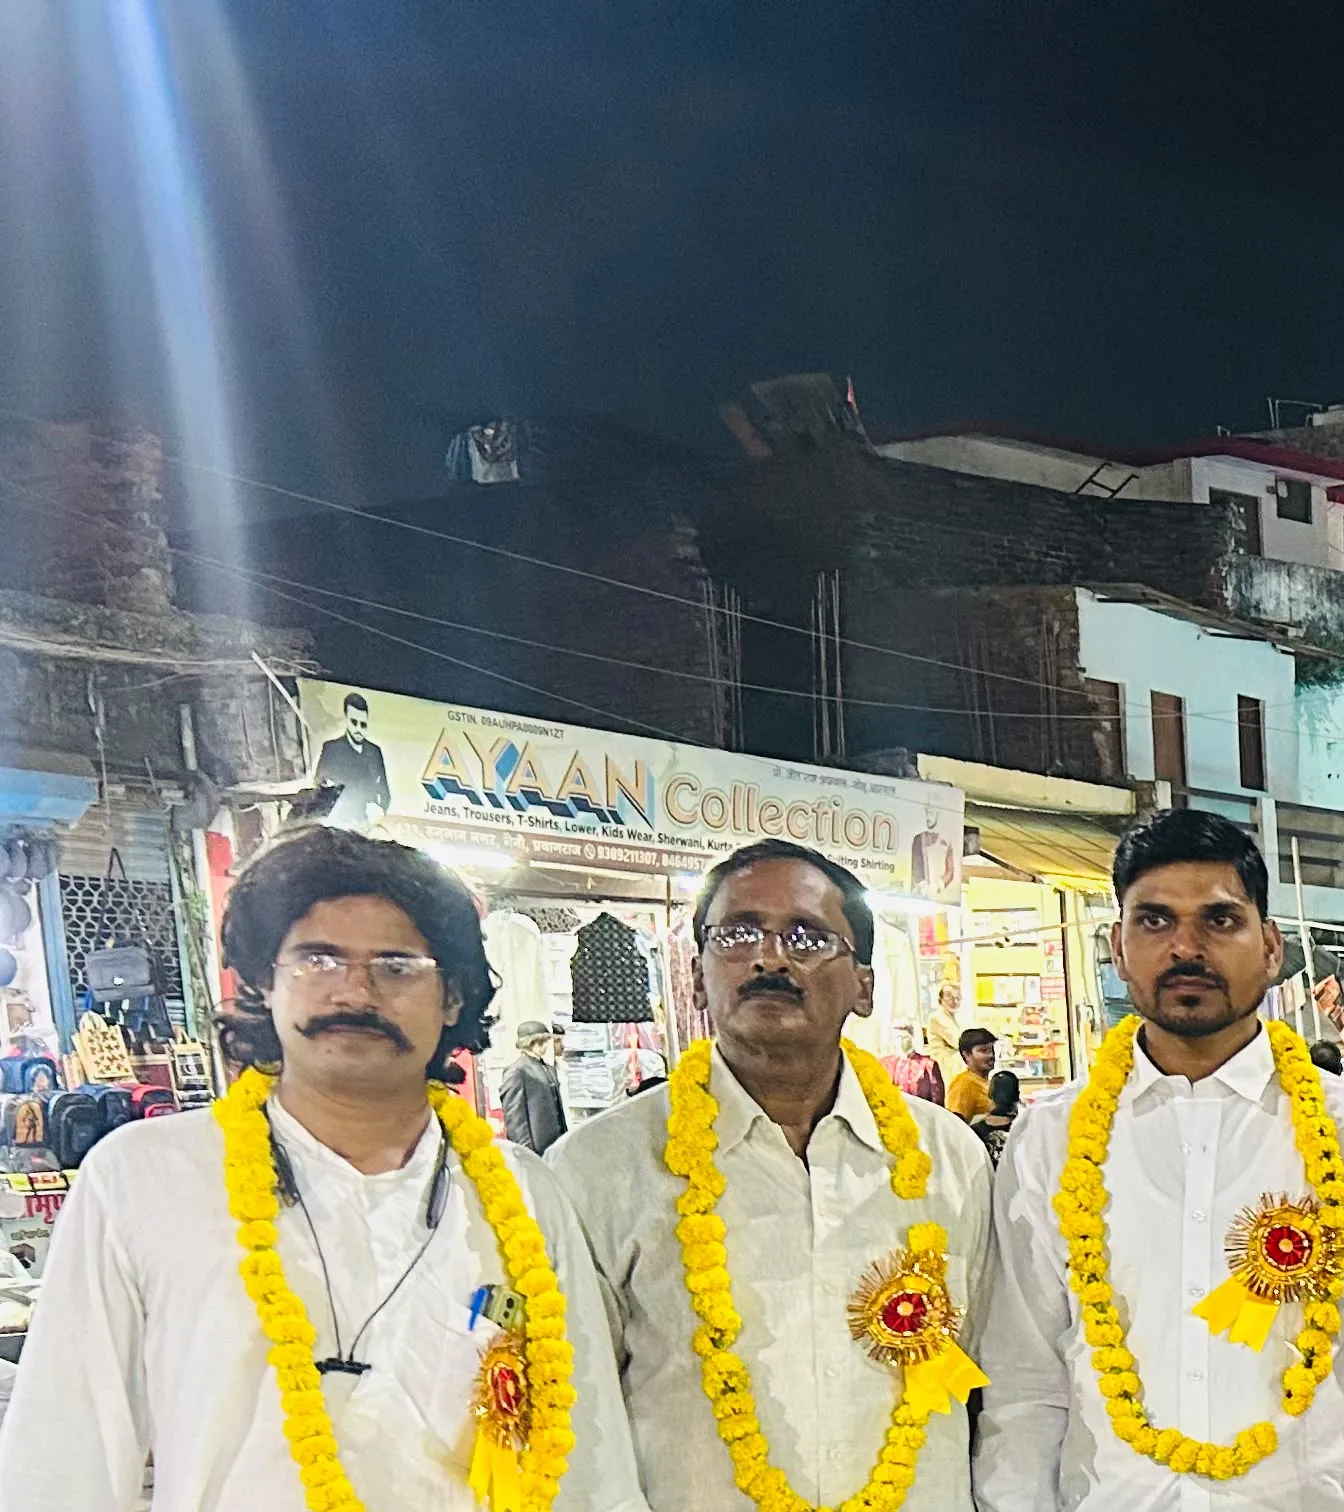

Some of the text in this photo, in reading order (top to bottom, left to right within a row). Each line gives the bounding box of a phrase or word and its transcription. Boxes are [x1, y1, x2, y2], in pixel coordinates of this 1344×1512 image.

[421, 728, 898, 852] AYAAN Collection
[424, 802, 460, 818] Jeans,
[463, 806, 515, 826] Trousers,
[517, 814, 562, 833] T-Shirts,
[565, 821, 598, 837] Lower,
[602, 826, 624, 839] Kids
[627, 830, 654, 845] Wear,
[657, 833, 705, 850] Sherwani,
[861, 858, 895, 873] Shirting
